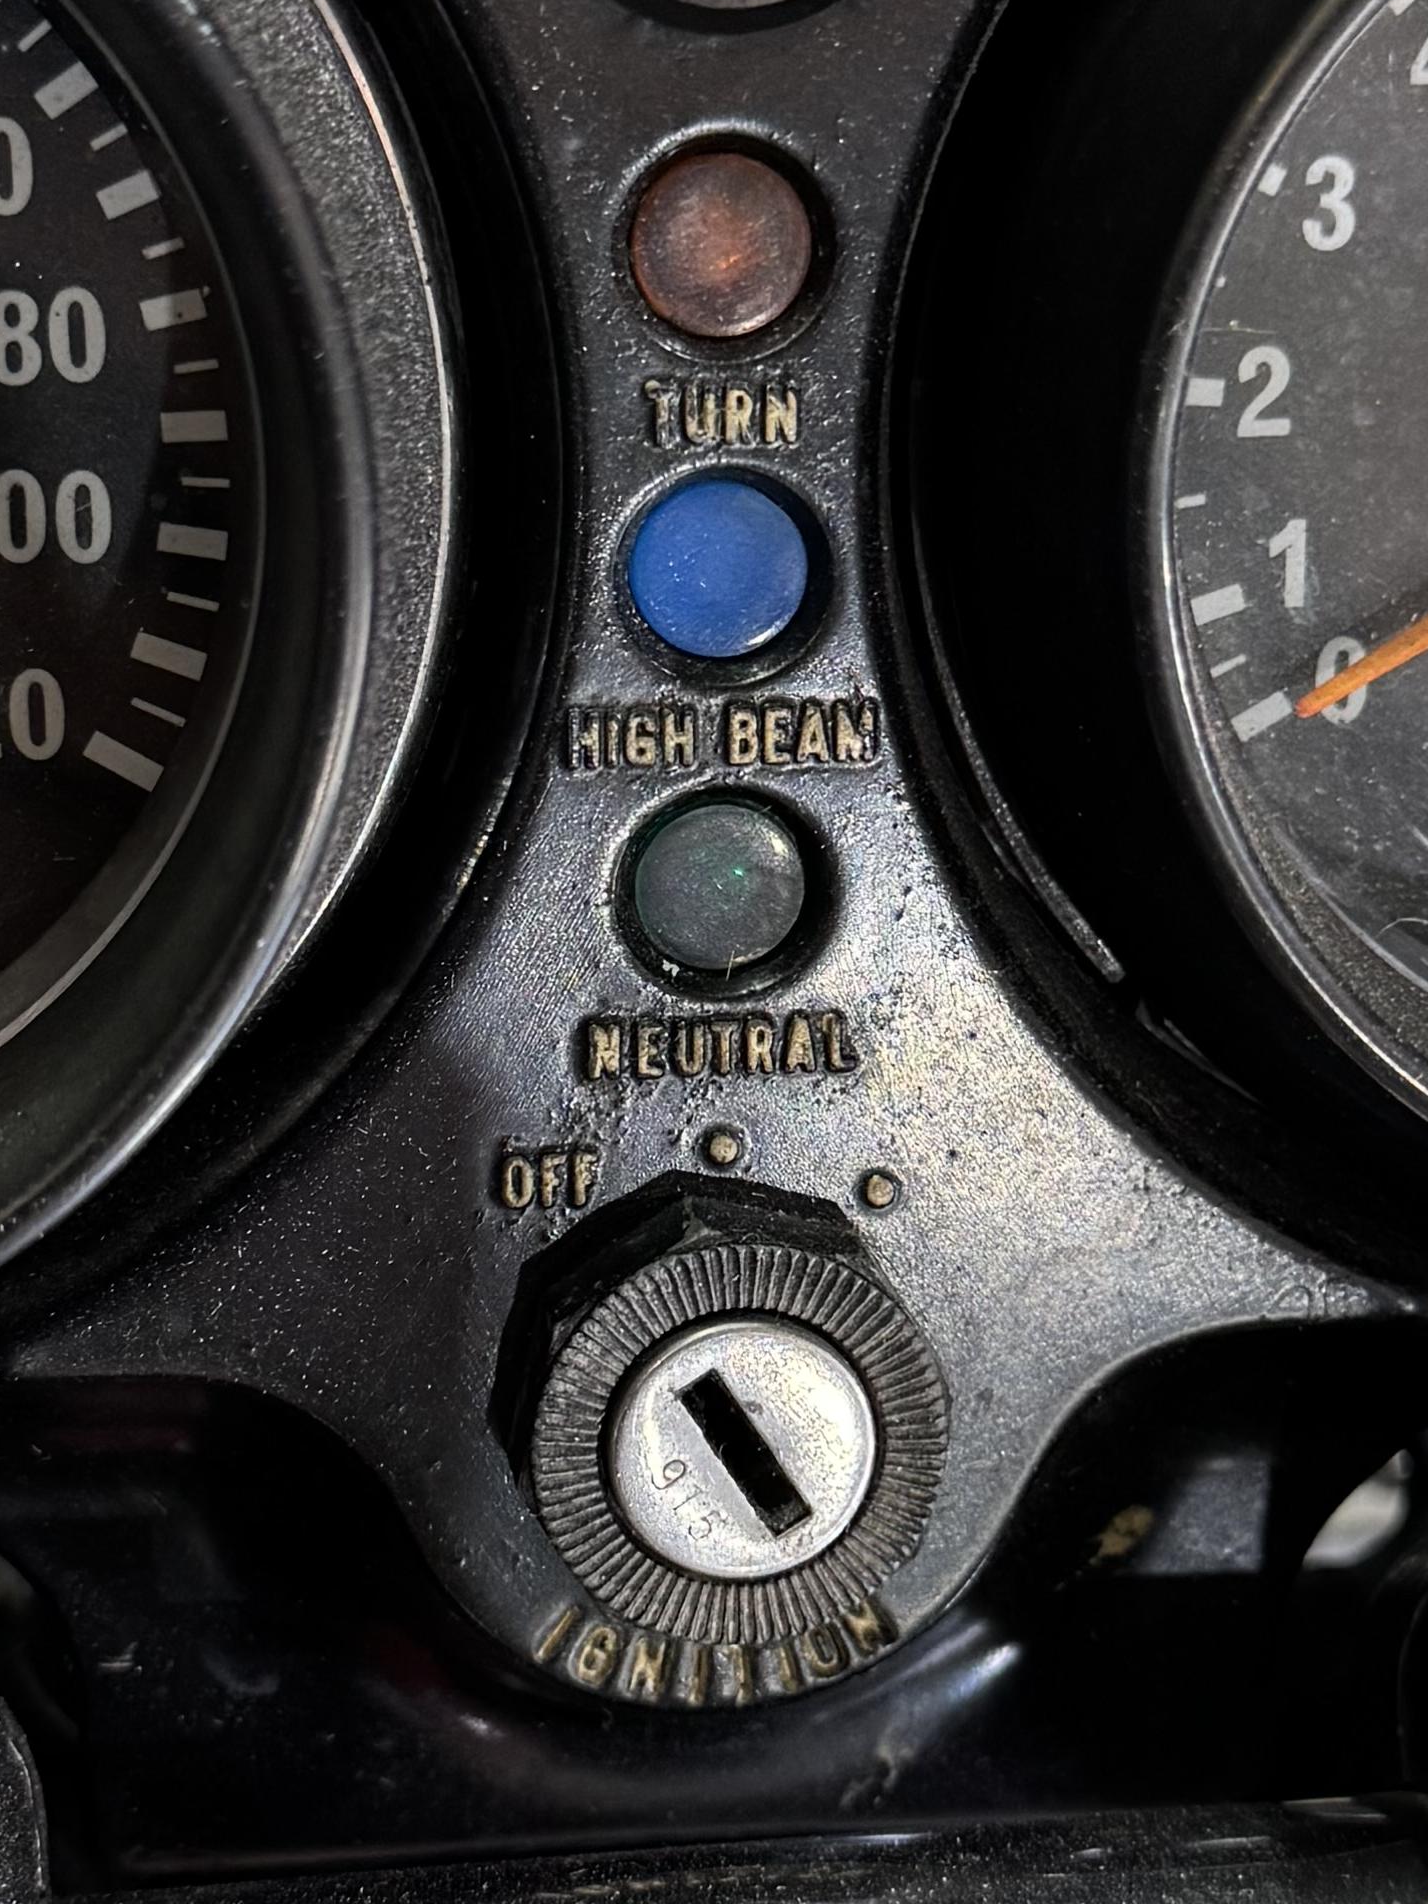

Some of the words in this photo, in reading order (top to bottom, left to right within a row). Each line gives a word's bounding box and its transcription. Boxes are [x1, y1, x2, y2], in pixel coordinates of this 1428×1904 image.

[1303, 155, 1356, 250] 3
[645, 379, 799, 446] TURN
[1237, 346, 1291, 438] 2
[1269, 519, 1307, 608] 1
[1315, 636, 1368, 725] 0
[568, 702, 696, 769] HIGH
[727, 700, 875, 766] BEAM
[586, 1011, 858, 1080] NEUTRAL
[500, 1147, 599, 1209] OFF
